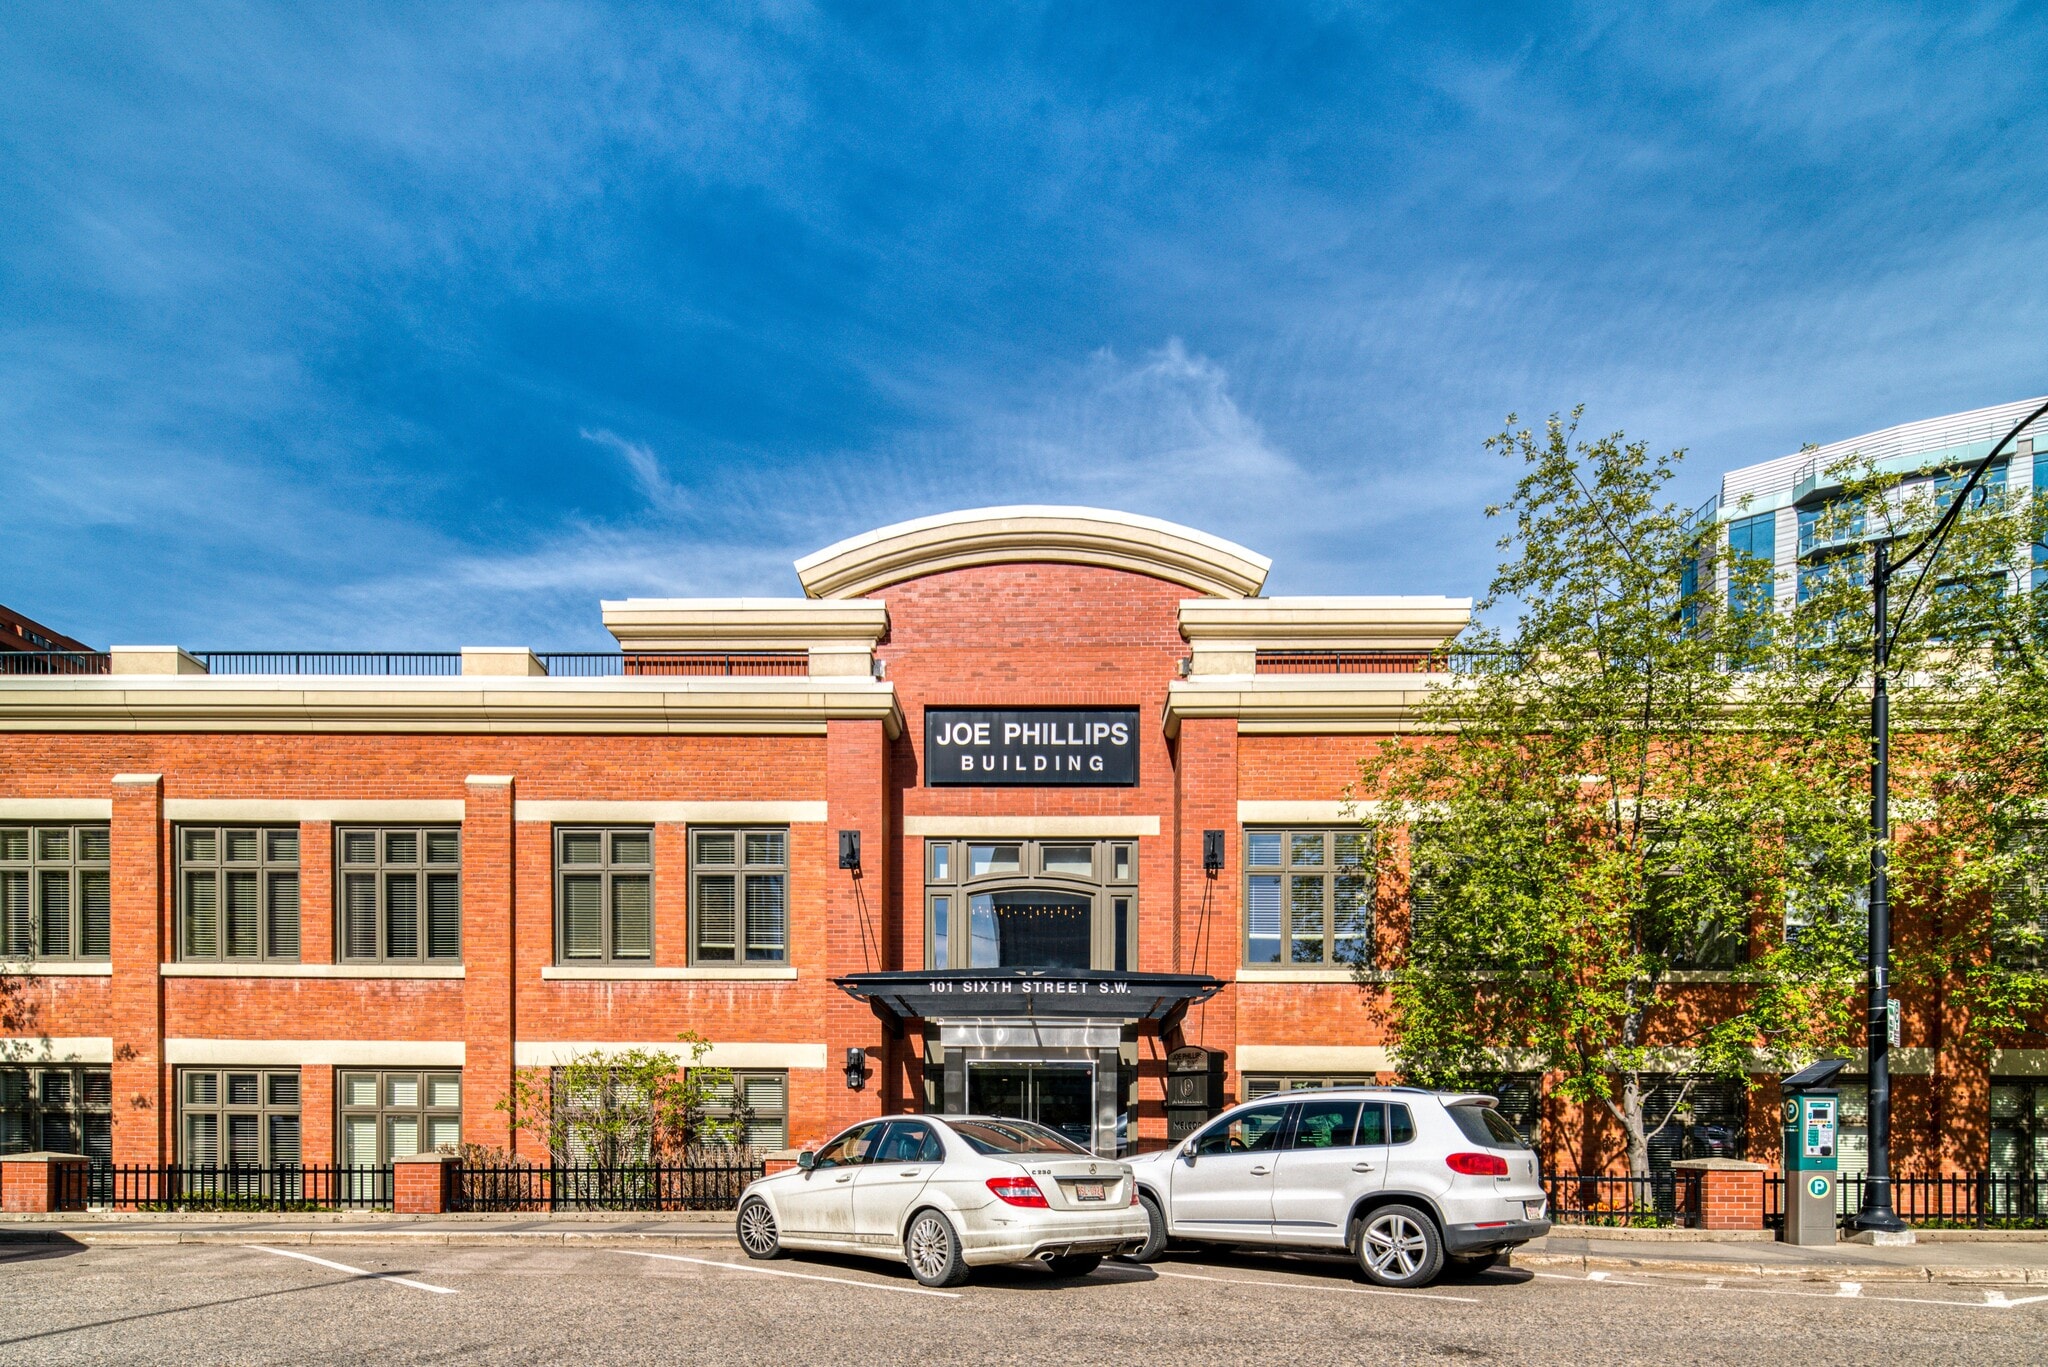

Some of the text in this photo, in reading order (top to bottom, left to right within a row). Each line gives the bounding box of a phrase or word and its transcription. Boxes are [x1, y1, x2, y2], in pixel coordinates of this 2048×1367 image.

[936, 722, 1129, 746] JOE PHILLIPS
[961, 755, 1104, 771] BUILDING
[929, 981, 1131, 994] 101 SIXTH STREET S.W.
